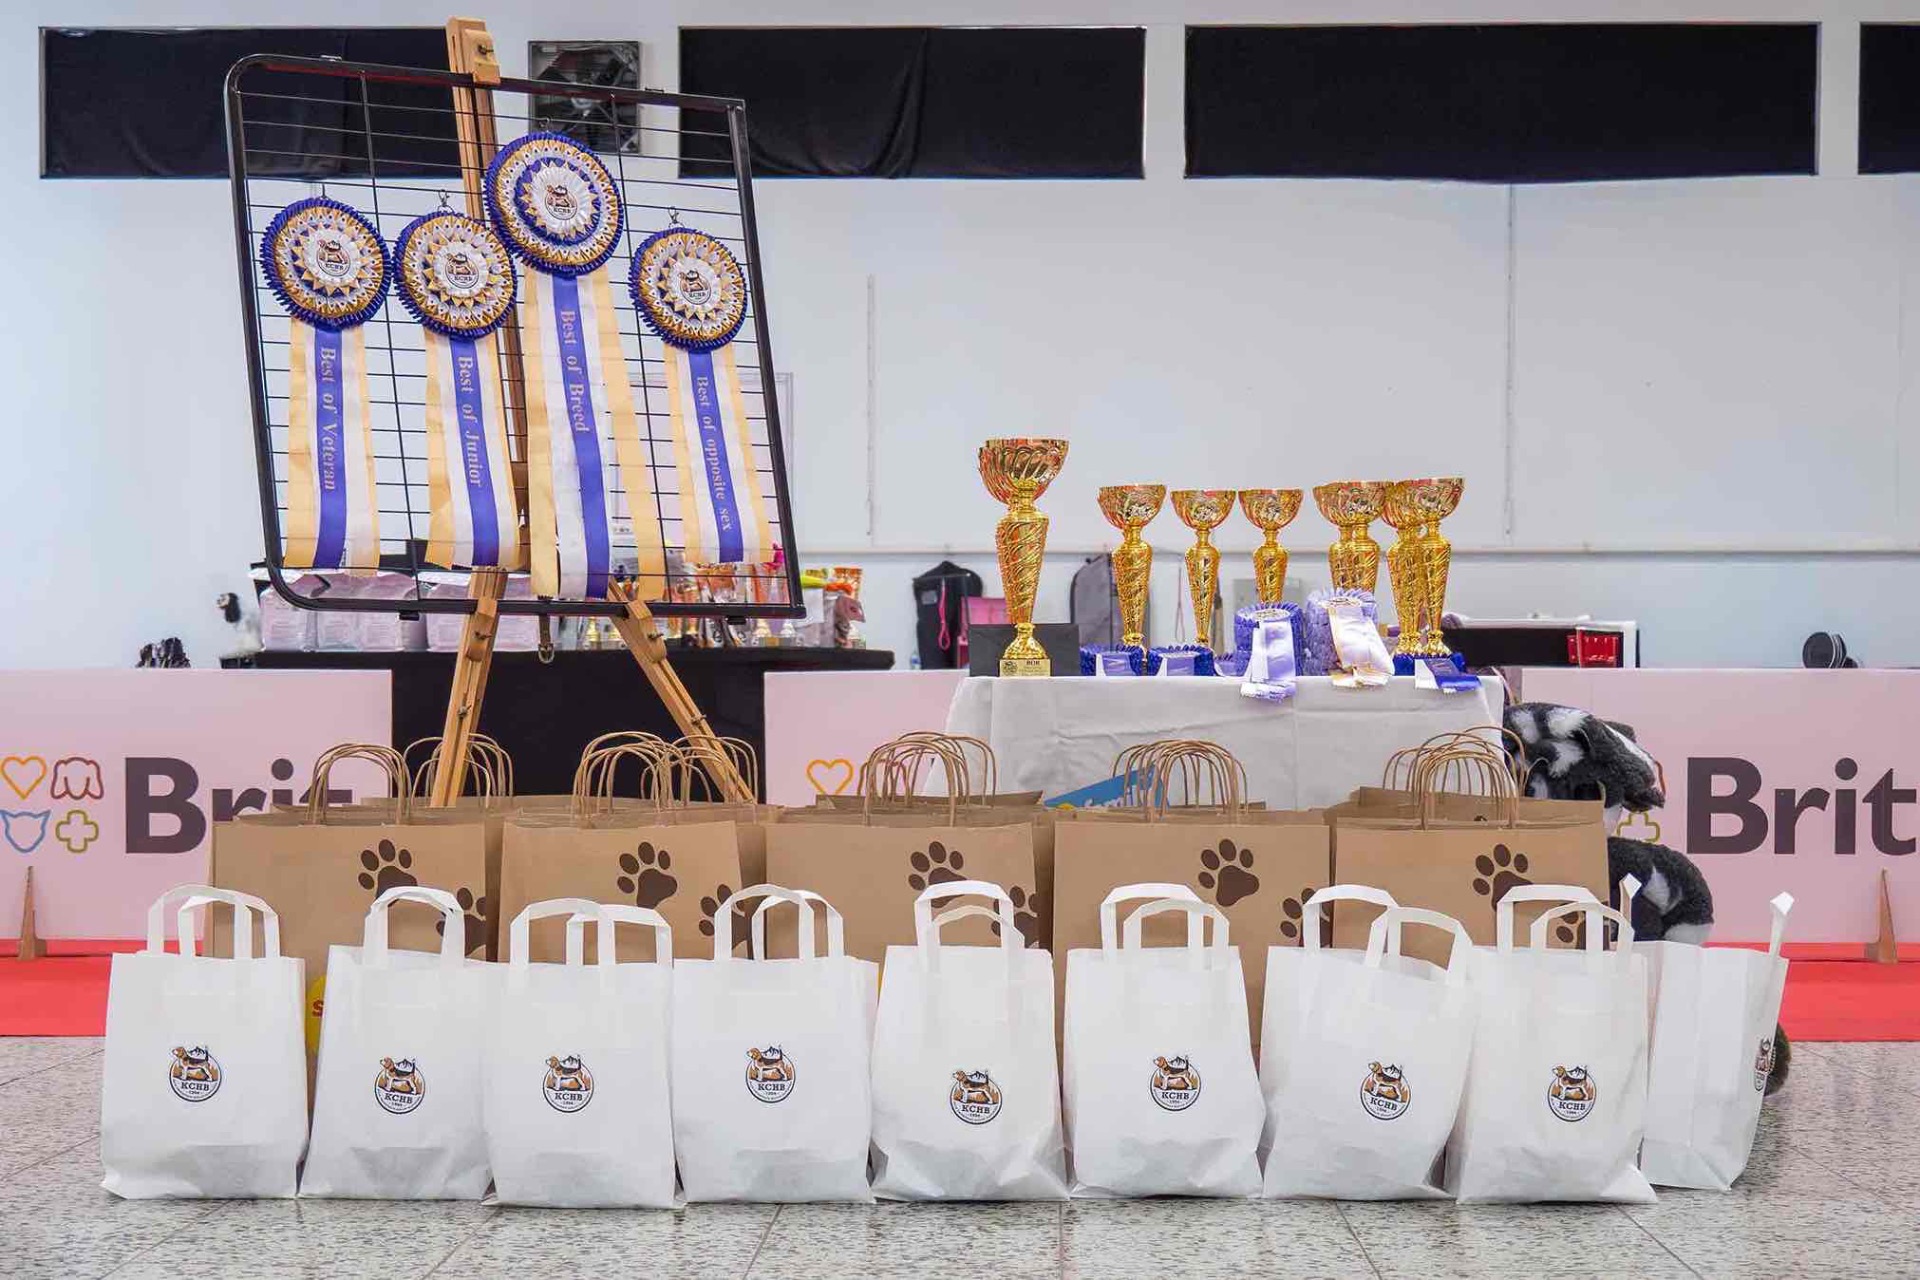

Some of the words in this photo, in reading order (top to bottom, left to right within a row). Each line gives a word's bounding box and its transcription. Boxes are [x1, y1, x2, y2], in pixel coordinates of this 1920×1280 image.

[560, 310, 578, 345] Best
[320, 347, 337, 383] Best
[458, 356, 474, 394] Best
[566, 355, 583, 376] of
[696, 376, 711, 409] Best
[322, 393, 338, 416] of
[462, 403, 478, 424] of
[569, 382, 590, 433] Breed
[702, 415, 717, 432] of
[322, 421, 338, 492] Veteran
[465, 430, 483, 488] Junior
[705, 438, 727, 501] opposite
[719, 507, 732, 533] sex
[125, 757, 352, 854] Br
[1687, 757, 1918, 856] Brit
[181, 1081, 210, 1091] KCHB
[555, 1092, 583, 1101] KCHB
[758, 1083, 786, 1091] KCHB
[1162, 1091, 1190, 1100] KCHB
[384, 1092, 413, 1104] KCHB
[961, 1104, 991, 1114] KCHB
[1370, 1097, 1398, 1111] KCHB
[1559, 1101, 1586, 1110] KCHB
